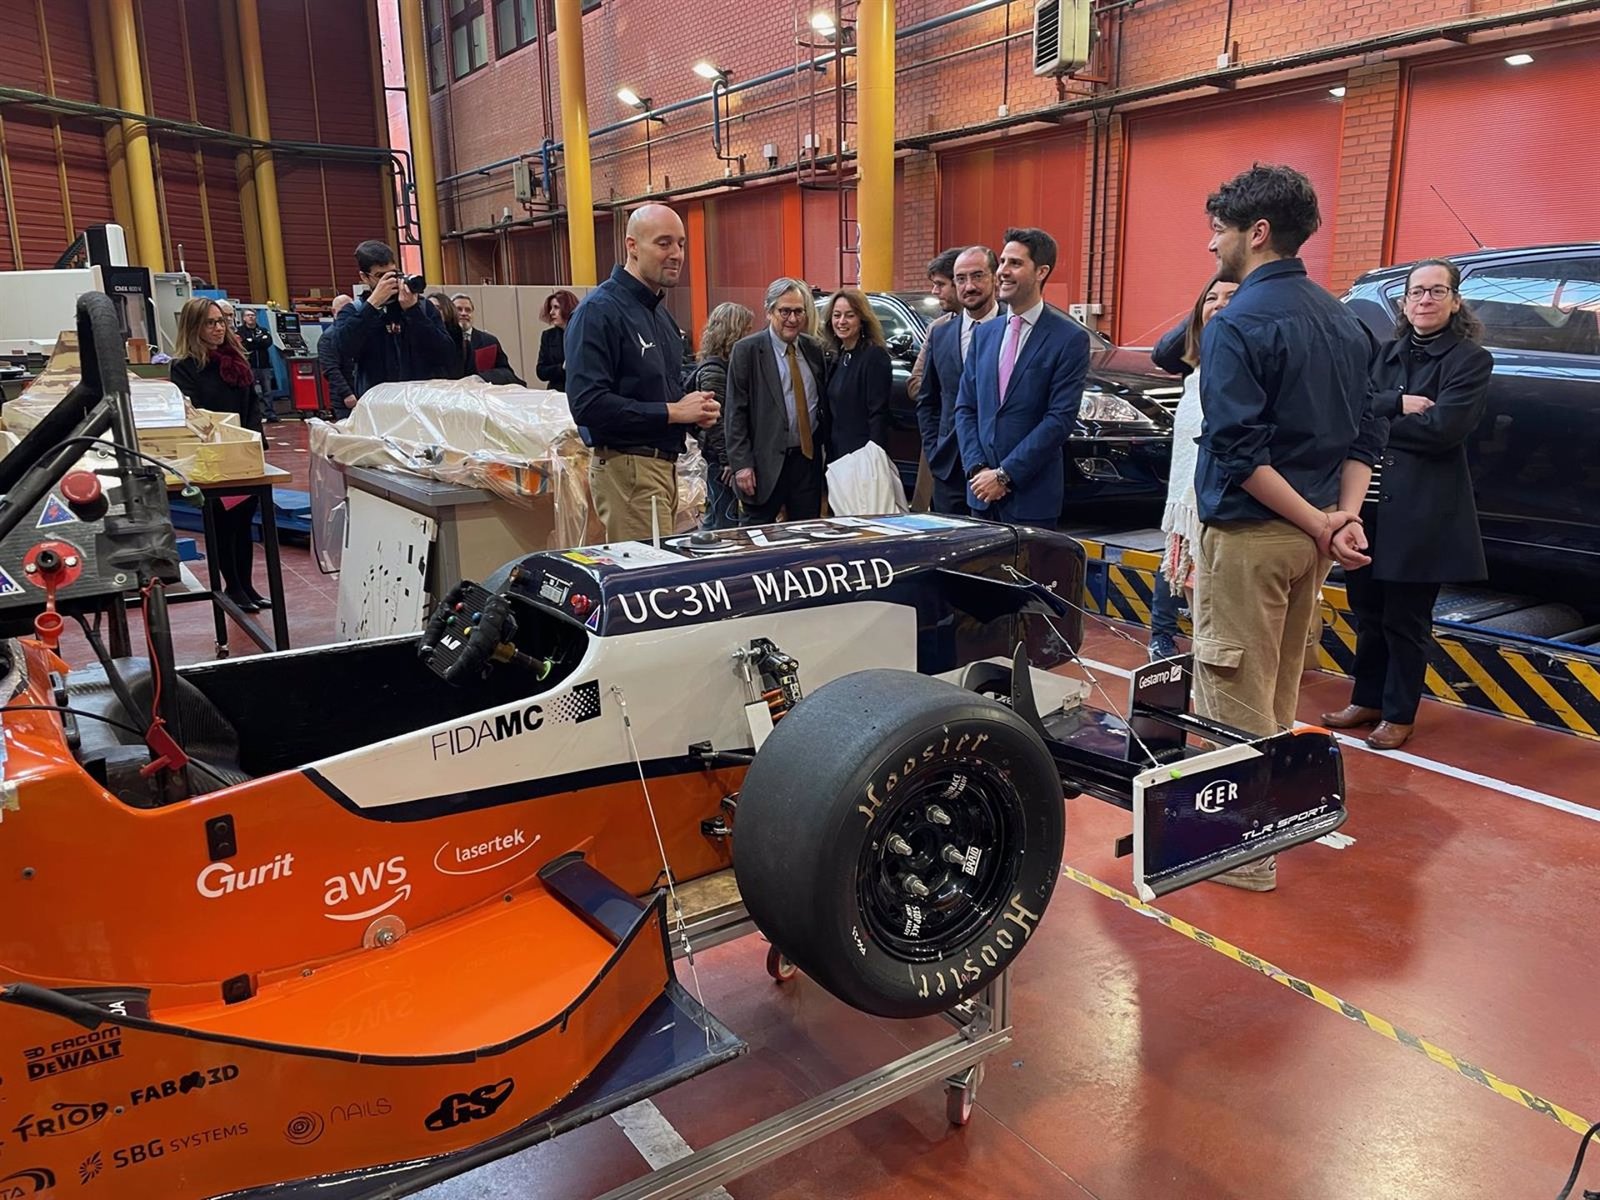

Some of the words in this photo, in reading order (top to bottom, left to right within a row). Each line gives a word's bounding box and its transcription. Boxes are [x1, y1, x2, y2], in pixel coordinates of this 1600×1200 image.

[618, 579, 732, 624] UC3M
[752, 558, 894, 605] MADRID
[1139, 670, 1169, 689] Gestamp
[431, 704, 544, 761] FIDAMC
[859, 725, 989, 828] Hoosier
[1242, 823, 1274, 840] TLR
[1277, 804, 1328, 828] SPORT
[455, 829, 525, 862] lasertek
[964, 846, 980, 876] BRAID
[197, 853, 294, 898] Gurit
[324, 856, 407, 906] aws
[918, 893, 1039, 999] Hoosier
[51, 1026, 121, 1053] FACOM
[113, 1139, 164, 1168] SBG
[170, 1122, 248, 1152] SYSTEMS
